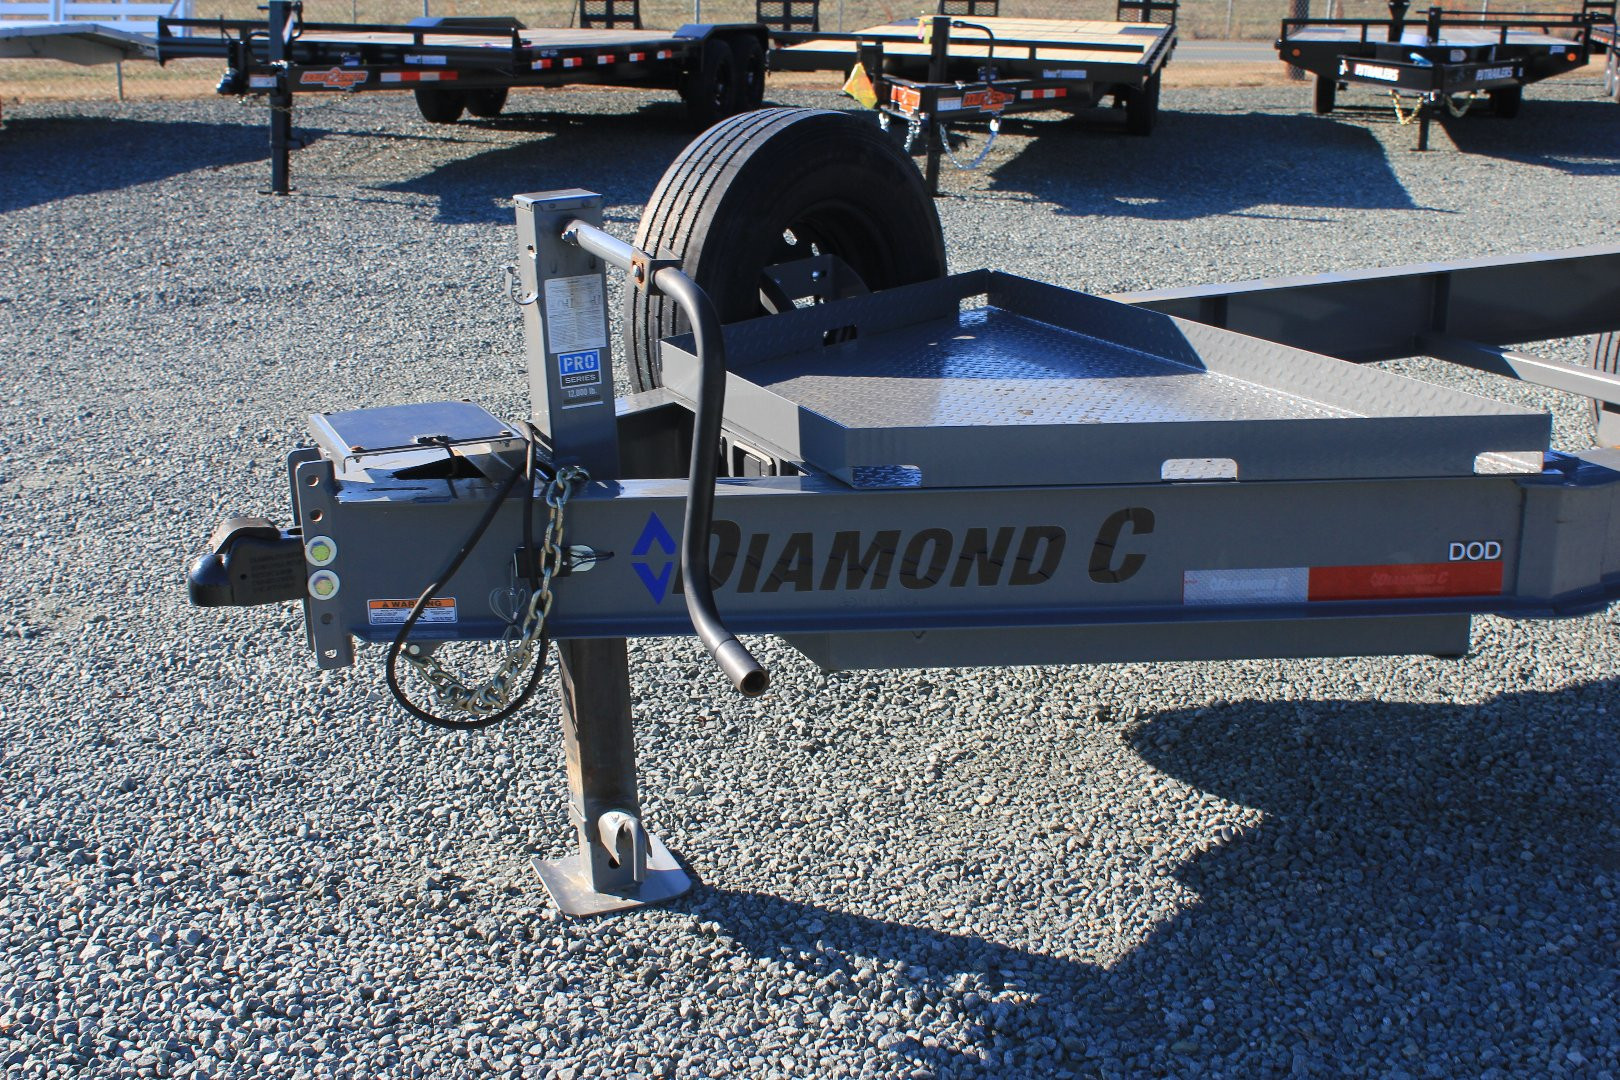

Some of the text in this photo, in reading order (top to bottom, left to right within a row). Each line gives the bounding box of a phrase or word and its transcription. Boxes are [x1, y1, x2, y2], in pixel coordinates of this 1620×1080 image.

[563, 355, 595, 373] PRO
[565, 374, 596, 384] SERIES
[672, 506, 1156, 595] DIAMOND C
[1448, 541, 1502, 561] DOD
[392, 600, 442, 609] WARNG
